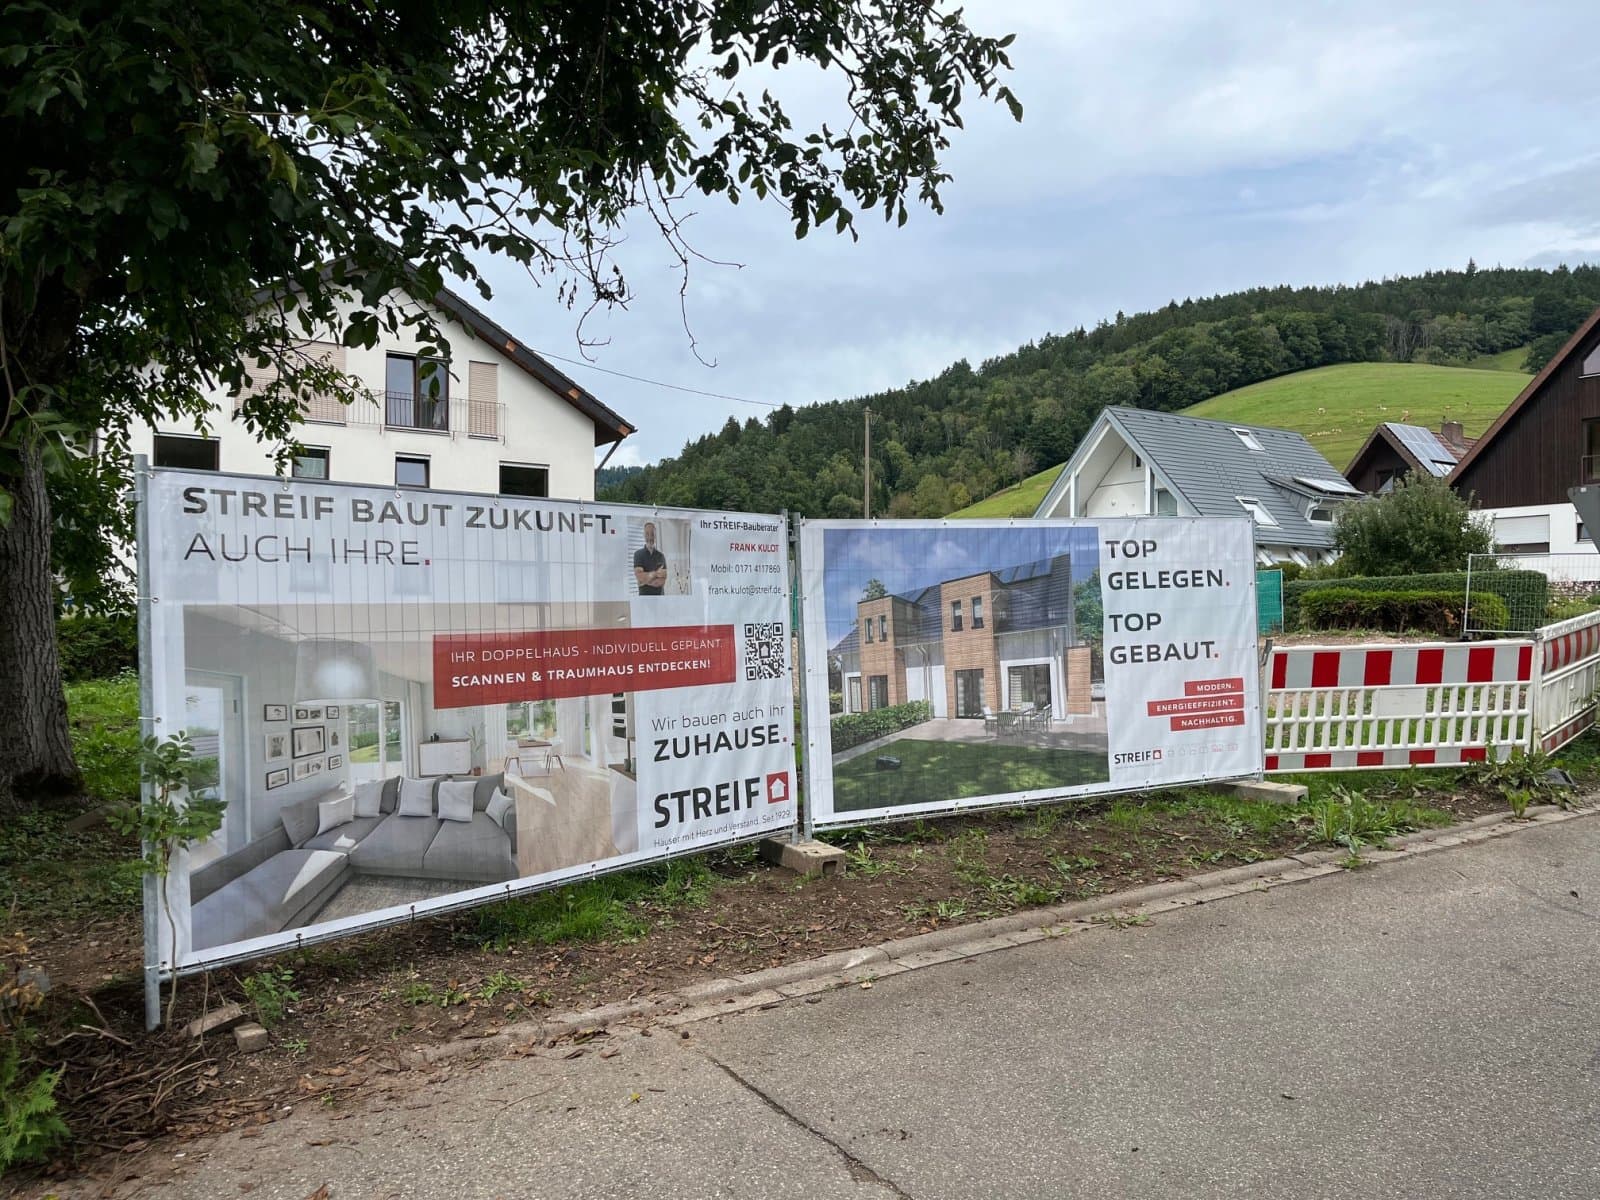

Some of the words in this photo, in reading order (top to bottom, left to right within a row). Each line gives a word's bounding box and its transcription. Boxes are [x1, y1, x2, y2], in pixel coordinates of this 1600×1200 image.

[183, 487, 335, 521] STREIF
[352, 499, 453, 527] BAUT
[466, 505, 616, 535] ZUKUNFT.
[700, 519, 712, 529] Ihr
[713, 520, 779, 532] STREIF-Bauberater
[184, 532, 311, 563] AUCH
[331, 538, 431, 566] IHRE.
[729, 543, 757, 552] FRANK
[757, 544, 779, 553] KULOT
[1105, 539, 1158, 559] TOP
[710, 564, 733, 573] Mobil:
[735, 564, 752, 573] 0171
[708, 584, 782, 596] frank.kulot@streif.de
[1108, 569, 1231, 591] GELEGEN.
[1108, 612, 1162, 633] TOP
[451, 651, 476, 663] IHR
[482, 645, 579, 662] DOPPELHAUS
[592, 641, 668, 655] INDIVIDUELL
[671, 638, 723, 651] GEPLANT.
[1110, 641, 1220, 665] GEBAUT.
[452, 671, 526, 688] SCANNEN
[531, 670, 542, 682] &
[547, 664, 634, 681] TRAUMHAUS
[638, 659, 711, 674] ENTDECKEN!
[1196, 682, 1235, 692] MODERN.
[1156, 698, 1237, 713] ENERGIEEFFIZIENT.
[652, 718, 677, 732] Wir
[682, 712, 727, 728] bauen
[732, 706, 764, 722] auch
[769, 704, 785, 717] Ihr
[1181, 715, 1237, 727] NACHHALTIG.
[654, 723, 788, 762] ZUHAUSE.
[1114, 750, 1151, 765] STREIF
[654, 777, 761, 829] STREIF
[682, 832, 694, 842] mit
[696, 828, 713, 840] Herz
[714, 823, 728, 835] und
